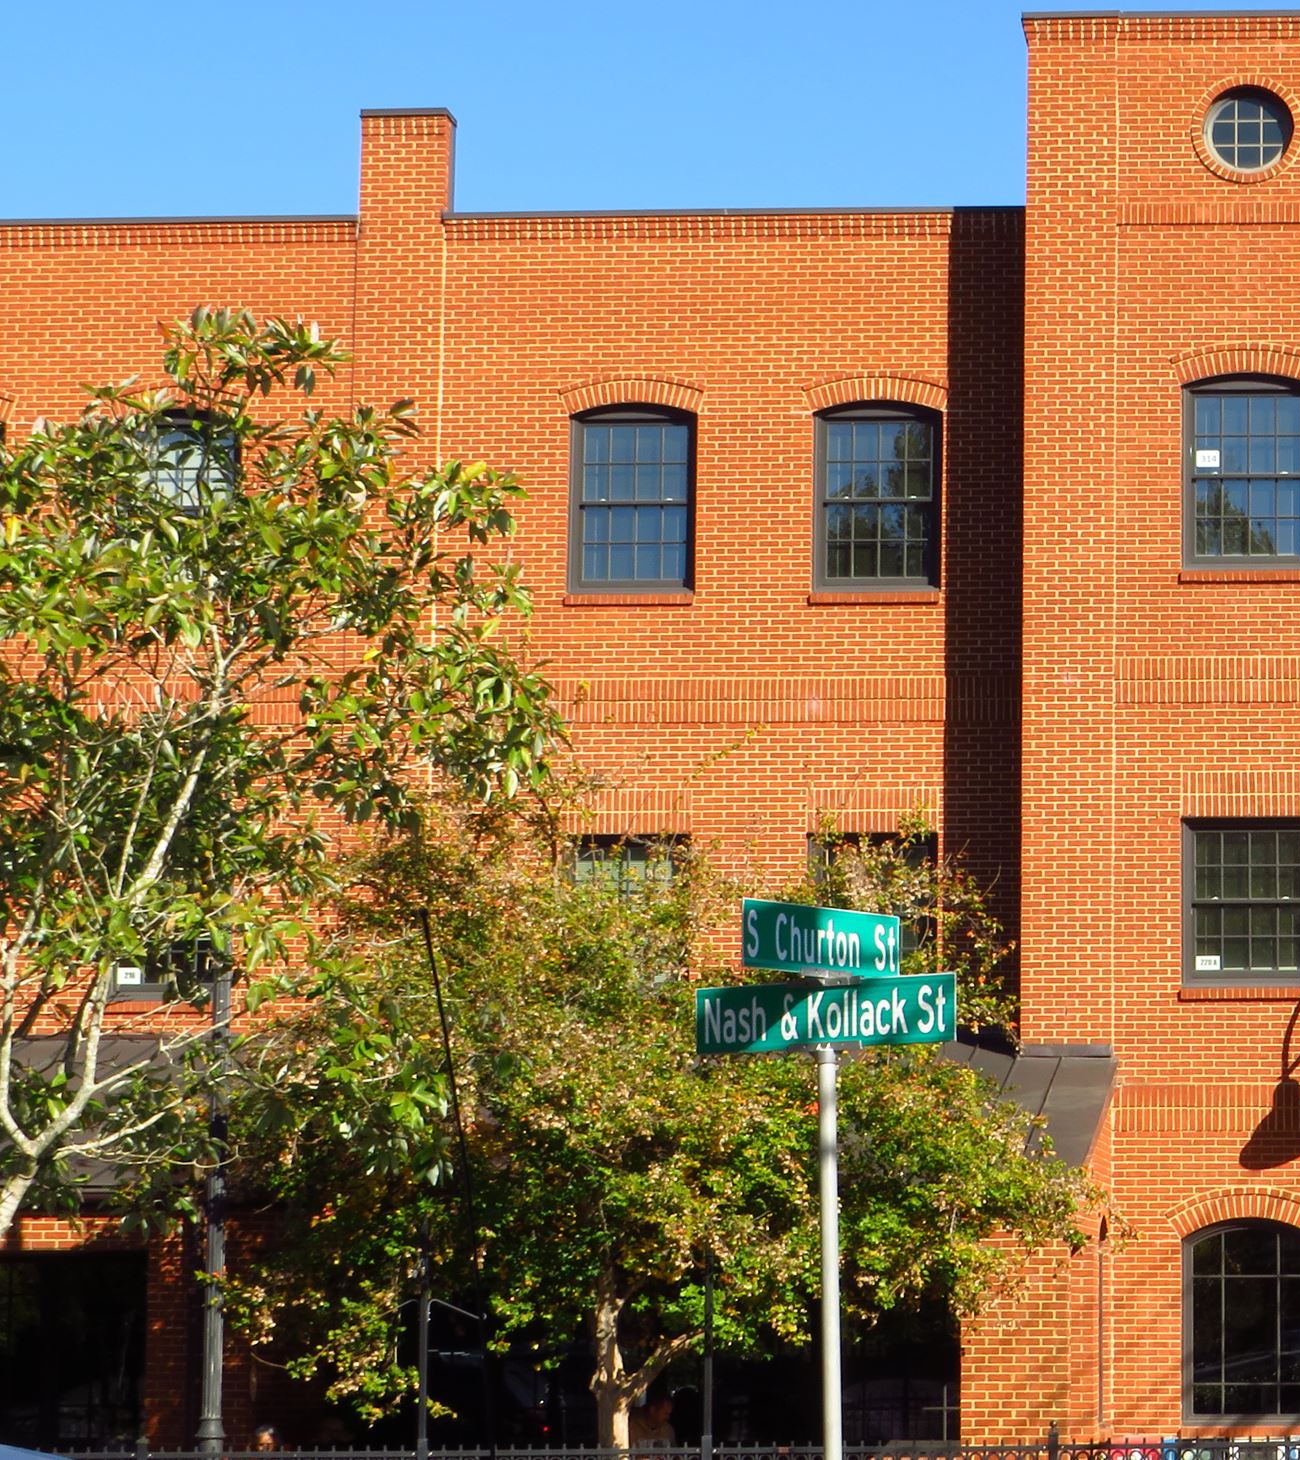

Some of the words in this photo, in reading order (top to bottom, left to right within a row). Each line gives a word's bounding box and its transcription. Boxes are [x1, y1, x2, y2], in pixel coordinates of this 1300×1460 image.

[746, 909, 760, 958] S
[775, 912, 861, 968] Churton
[874, 924, 896, 973] St
[704, 998, 767, 1044] Nash
[780, 993, 799, 1040] &
[807, 987, 909, 1039] Kollack
[917, 984, 947, 1034] St
